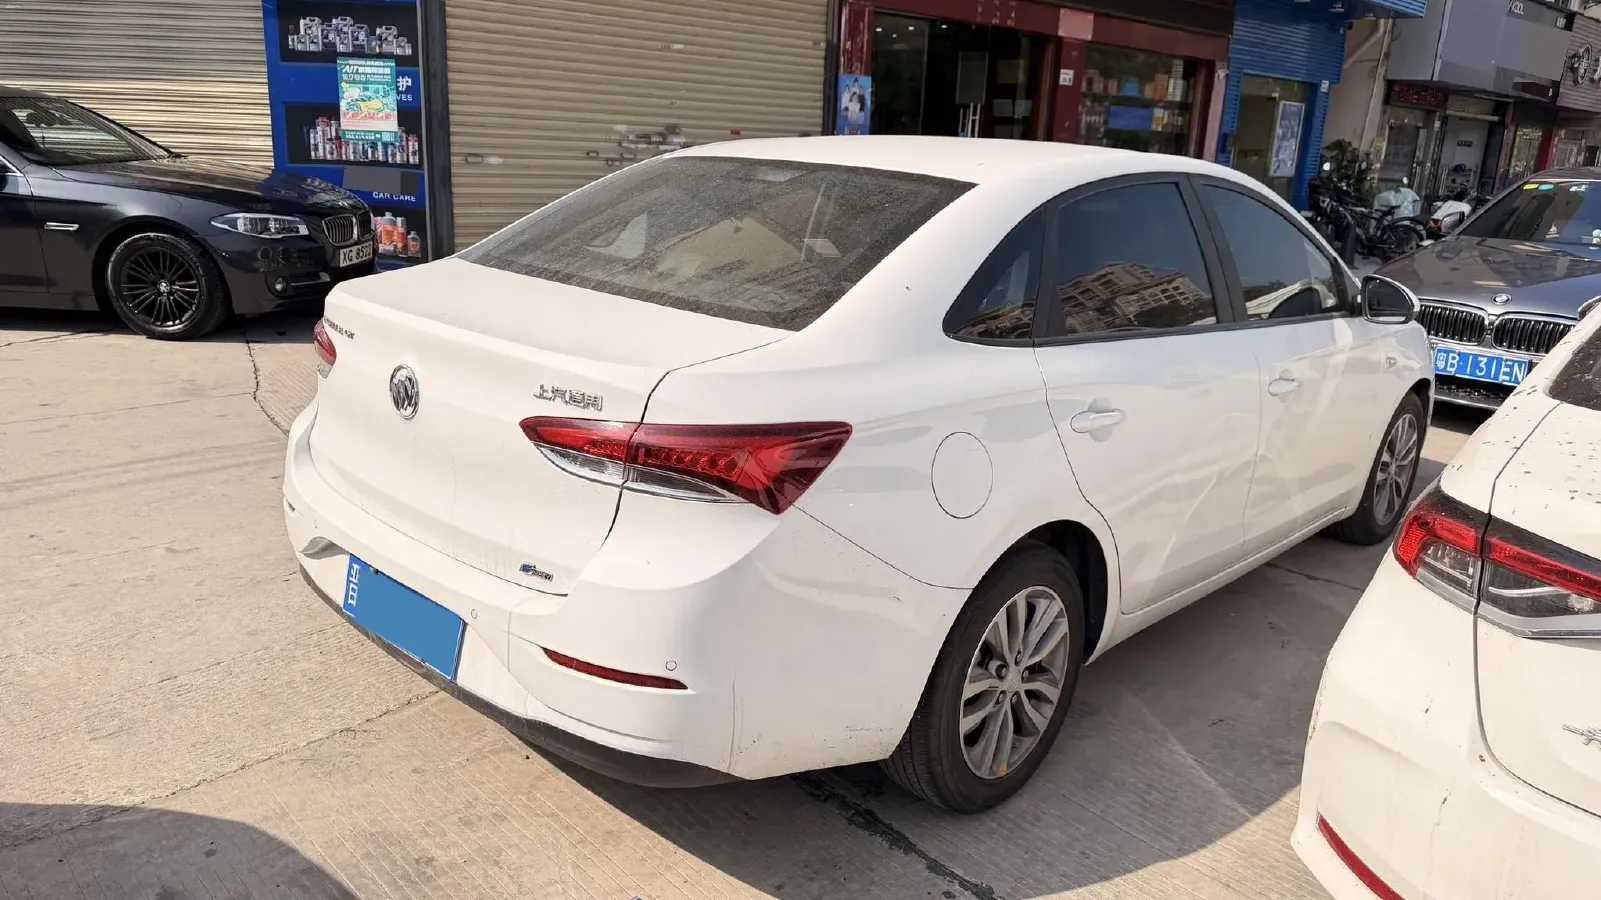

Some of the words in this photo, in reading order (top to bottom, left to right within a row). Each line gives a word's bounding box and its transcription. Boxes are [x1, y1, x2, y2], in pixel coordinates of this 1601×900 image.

[397, 76, 412, 91] 护
[372, 191, 390, 199] CAR
[342, 249, 353, 264] XG
